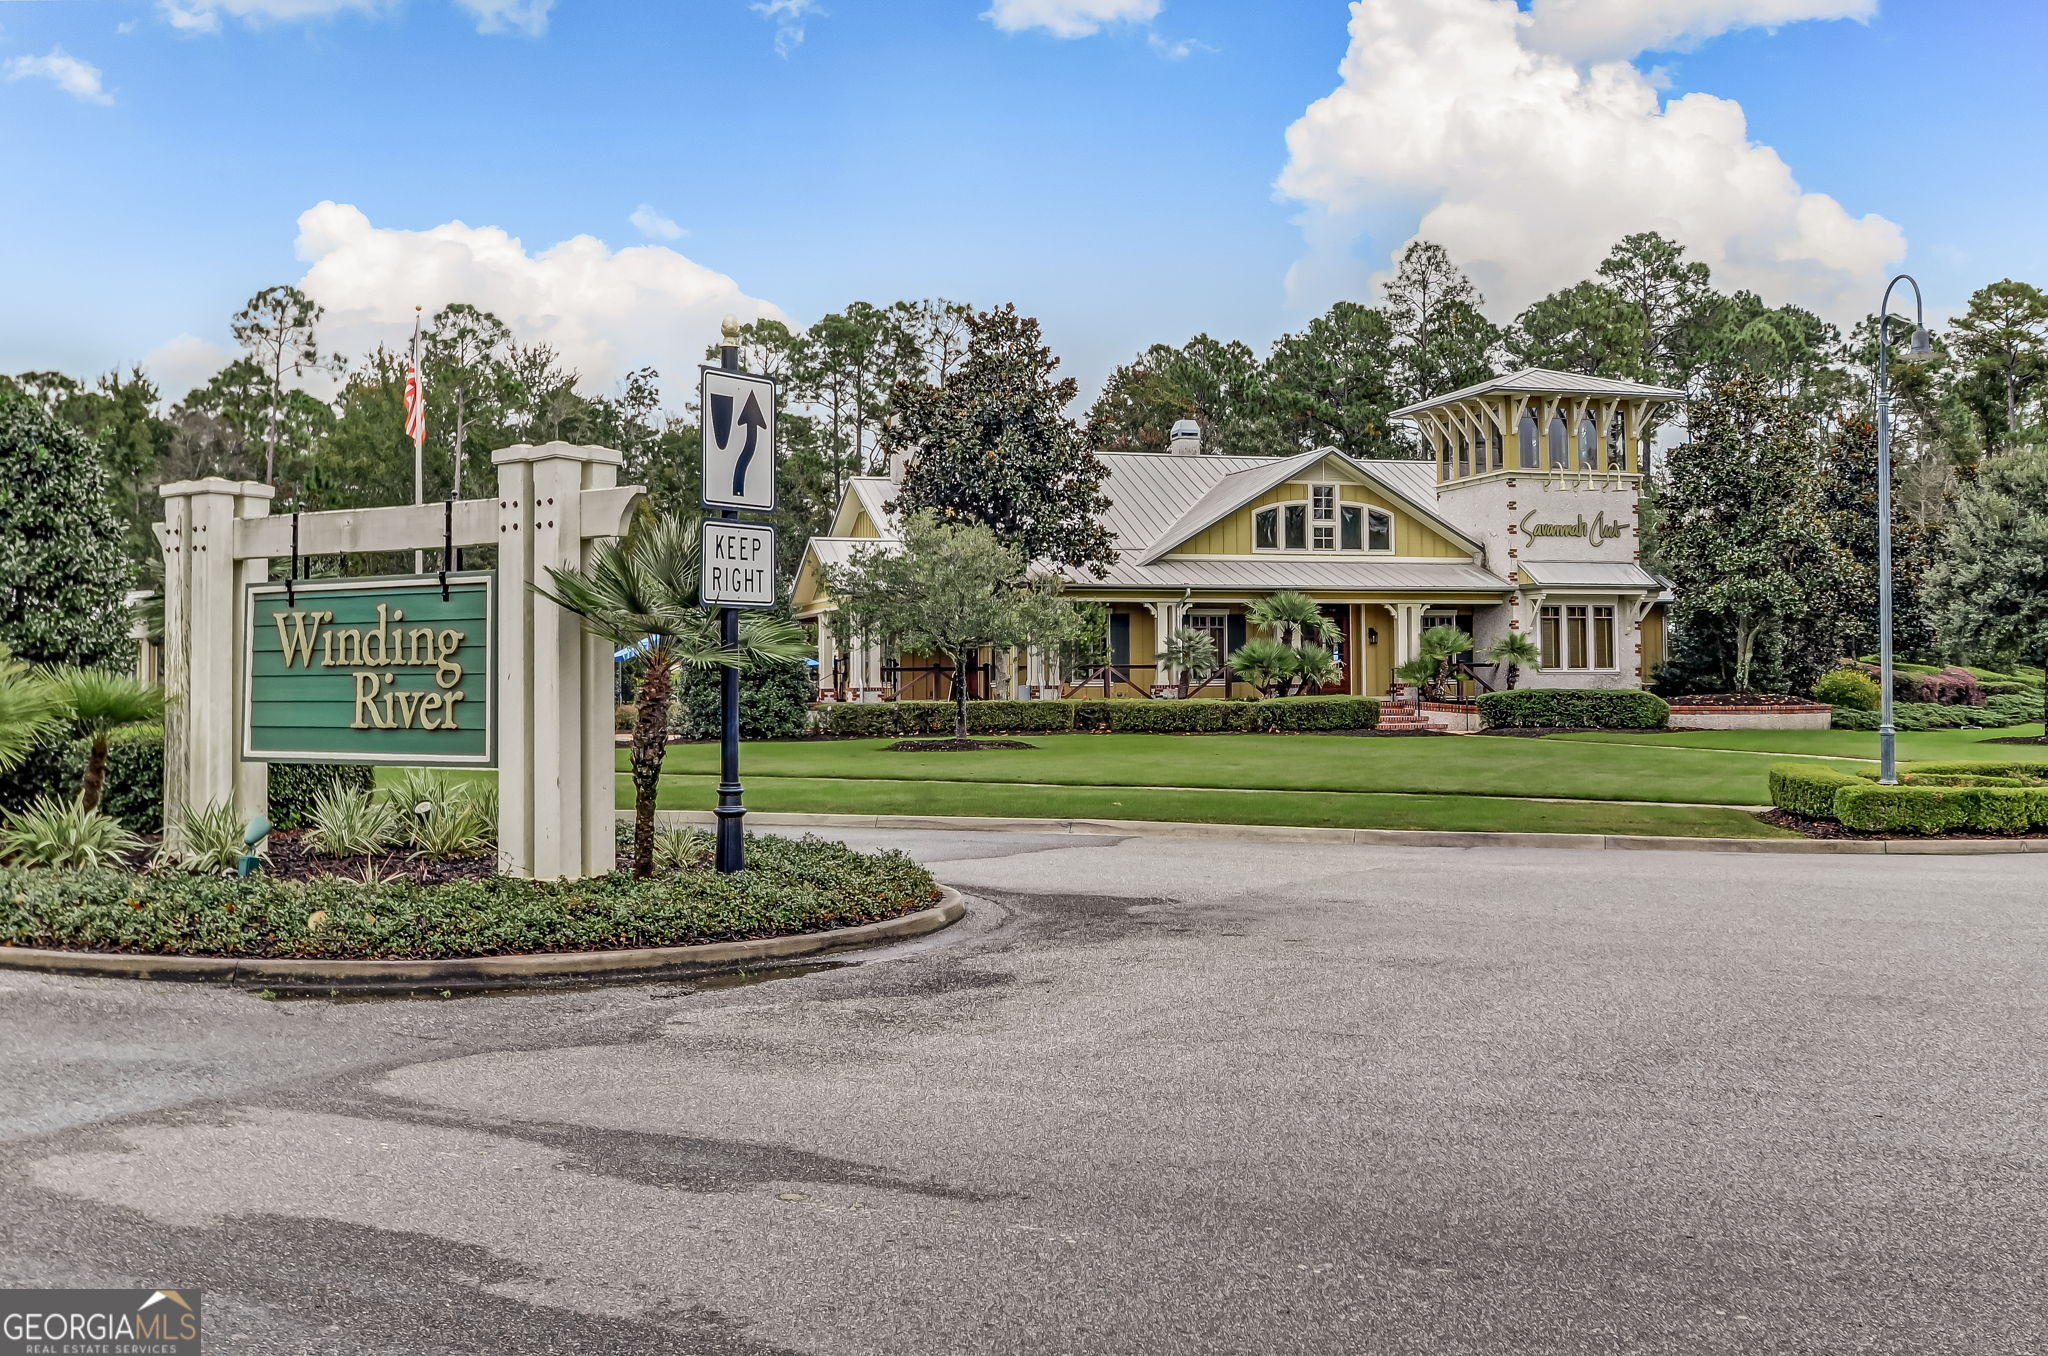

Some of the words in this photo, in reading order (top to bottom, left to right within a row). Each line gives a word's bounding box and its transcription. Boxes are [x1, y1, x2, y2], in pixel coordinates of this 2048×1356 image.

[715, 534, 761, 562] KEEP
[1520, 509, 1588, 548] Savannah
[712, 566, 764, 593] RIGHT
[273, 603, 465, 689] Winding
[350, 672, 465, 730] River
